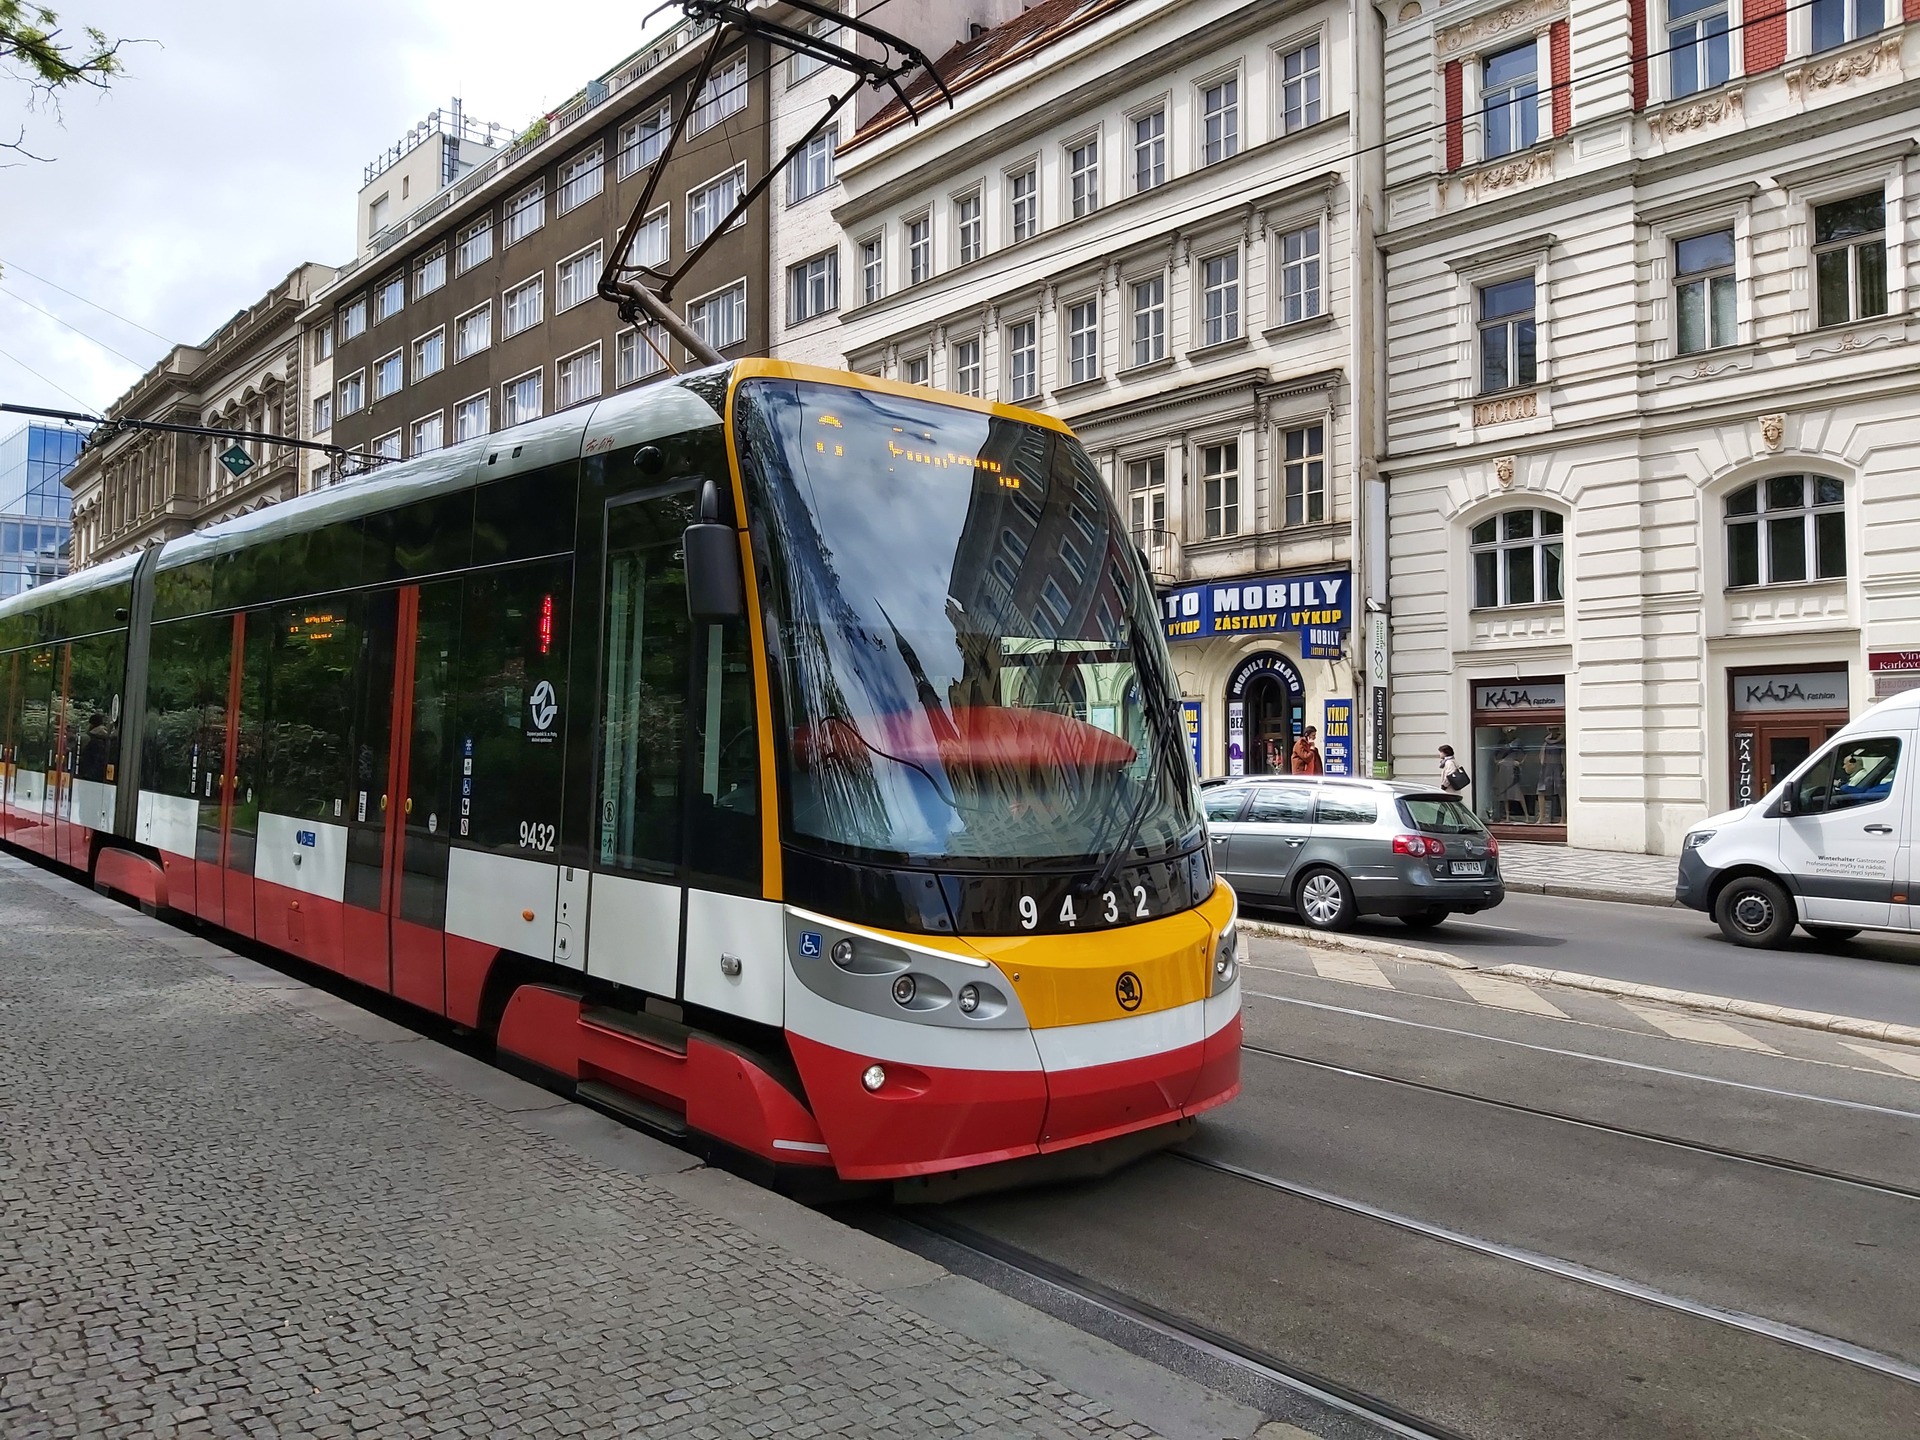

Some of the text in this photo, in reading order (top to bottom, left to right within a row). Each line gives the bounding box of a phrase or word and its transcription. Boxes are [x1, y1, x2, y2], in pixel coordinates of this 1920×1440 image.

[1213, 579, 1342, 612] MOBILY
[1168, 619, 1200, 636] VÝKUP
[1215, 614, 1277, 631] ZÁSTAVY
[1291, 609, 1342, 625] VÝKUP
[1310, 629, 1339, 645] MOBILY
[1900, 651, 1920, 660] Vin
[1233, 658, 1264, 695] MOBILY
[1273, 659, 1300, 692] ZLATO
[1485, 688, 1532, 708] KÁJA
[1746, 681, 1805, 702] KÁJA
[1327, 704, 1349, 721] VÝKUP
[1231, 717, 1243, 728] BEZ
[1327, 723, 1348, 736] ZLATA
[519, 820, 556, 853] 9432
